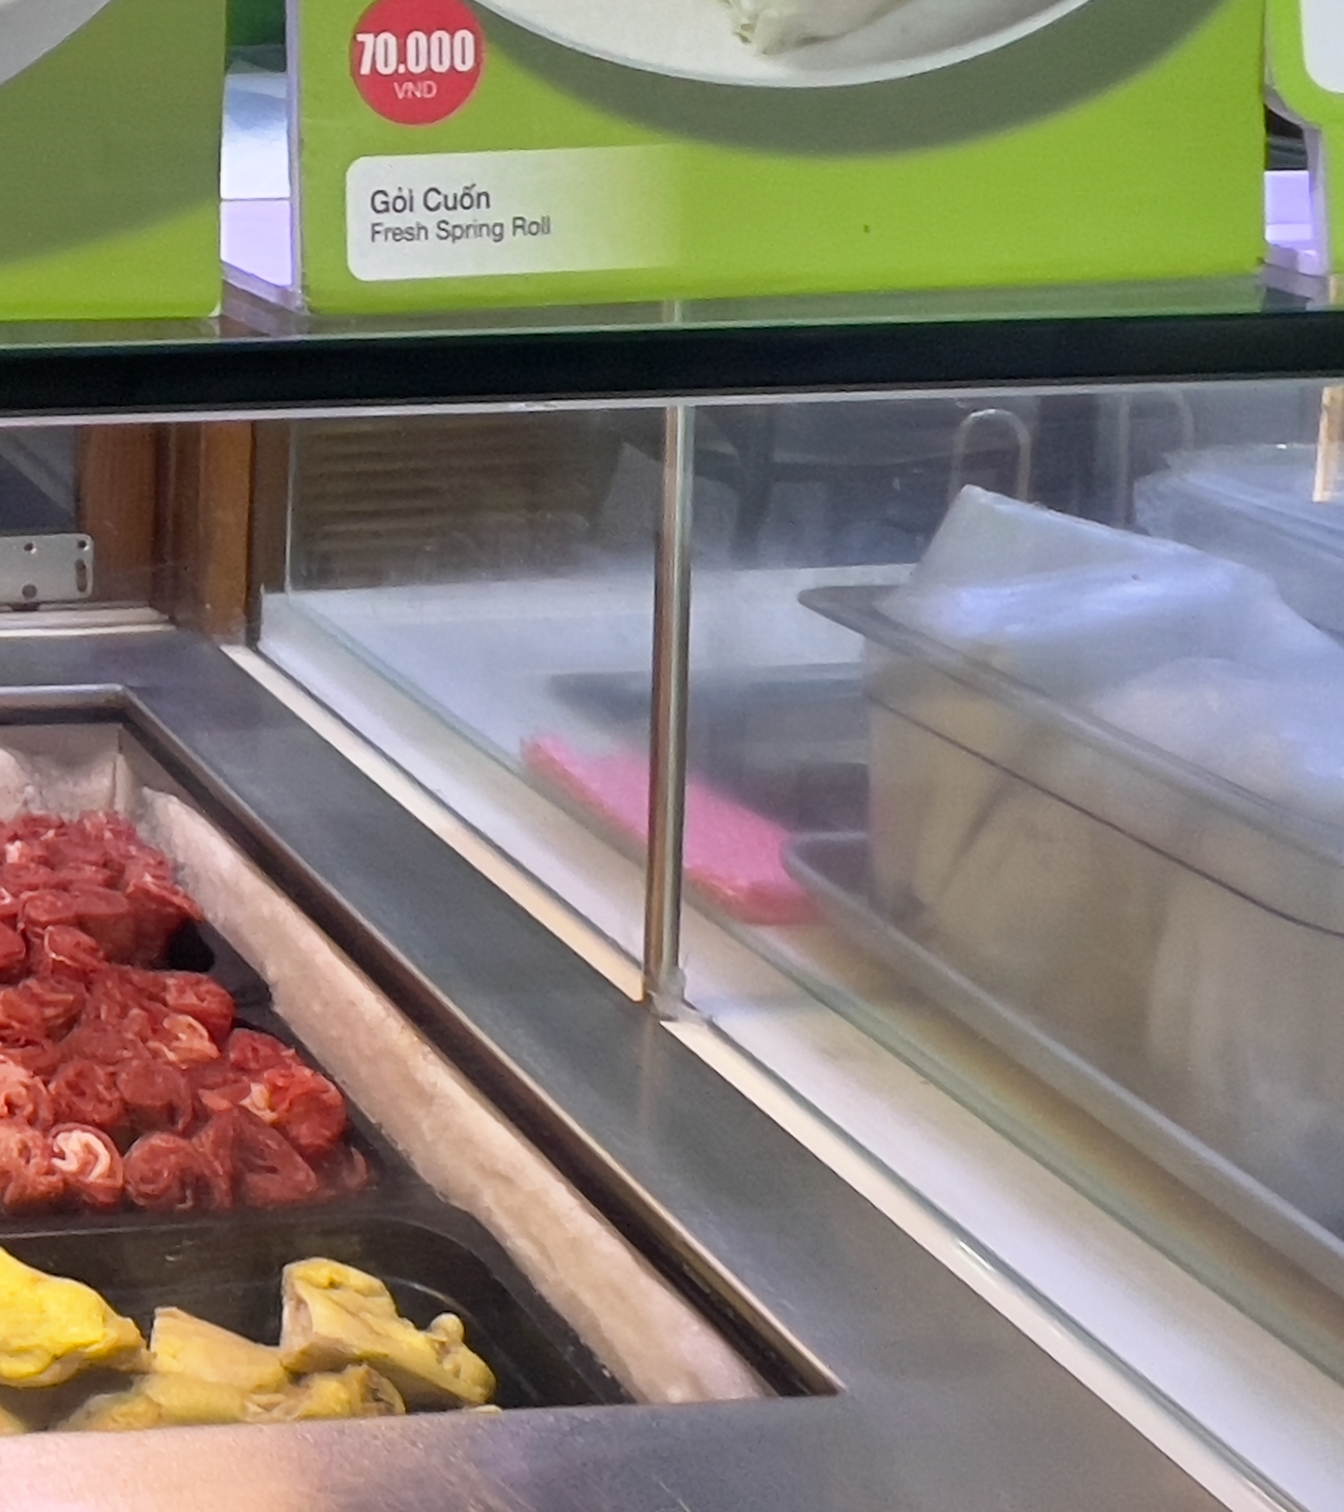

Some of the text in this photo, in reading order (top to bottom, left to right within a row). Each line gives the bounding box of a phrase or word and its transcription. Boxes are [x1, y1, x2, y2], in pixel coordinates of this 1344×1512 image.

[356, 30, 475, 75] 70.000
[393, 80, 437, 99] VND
[370, 183, 491, 214] Gỏi Cuốn
[371, 216, 550, 243] Fresh Spring Roll
